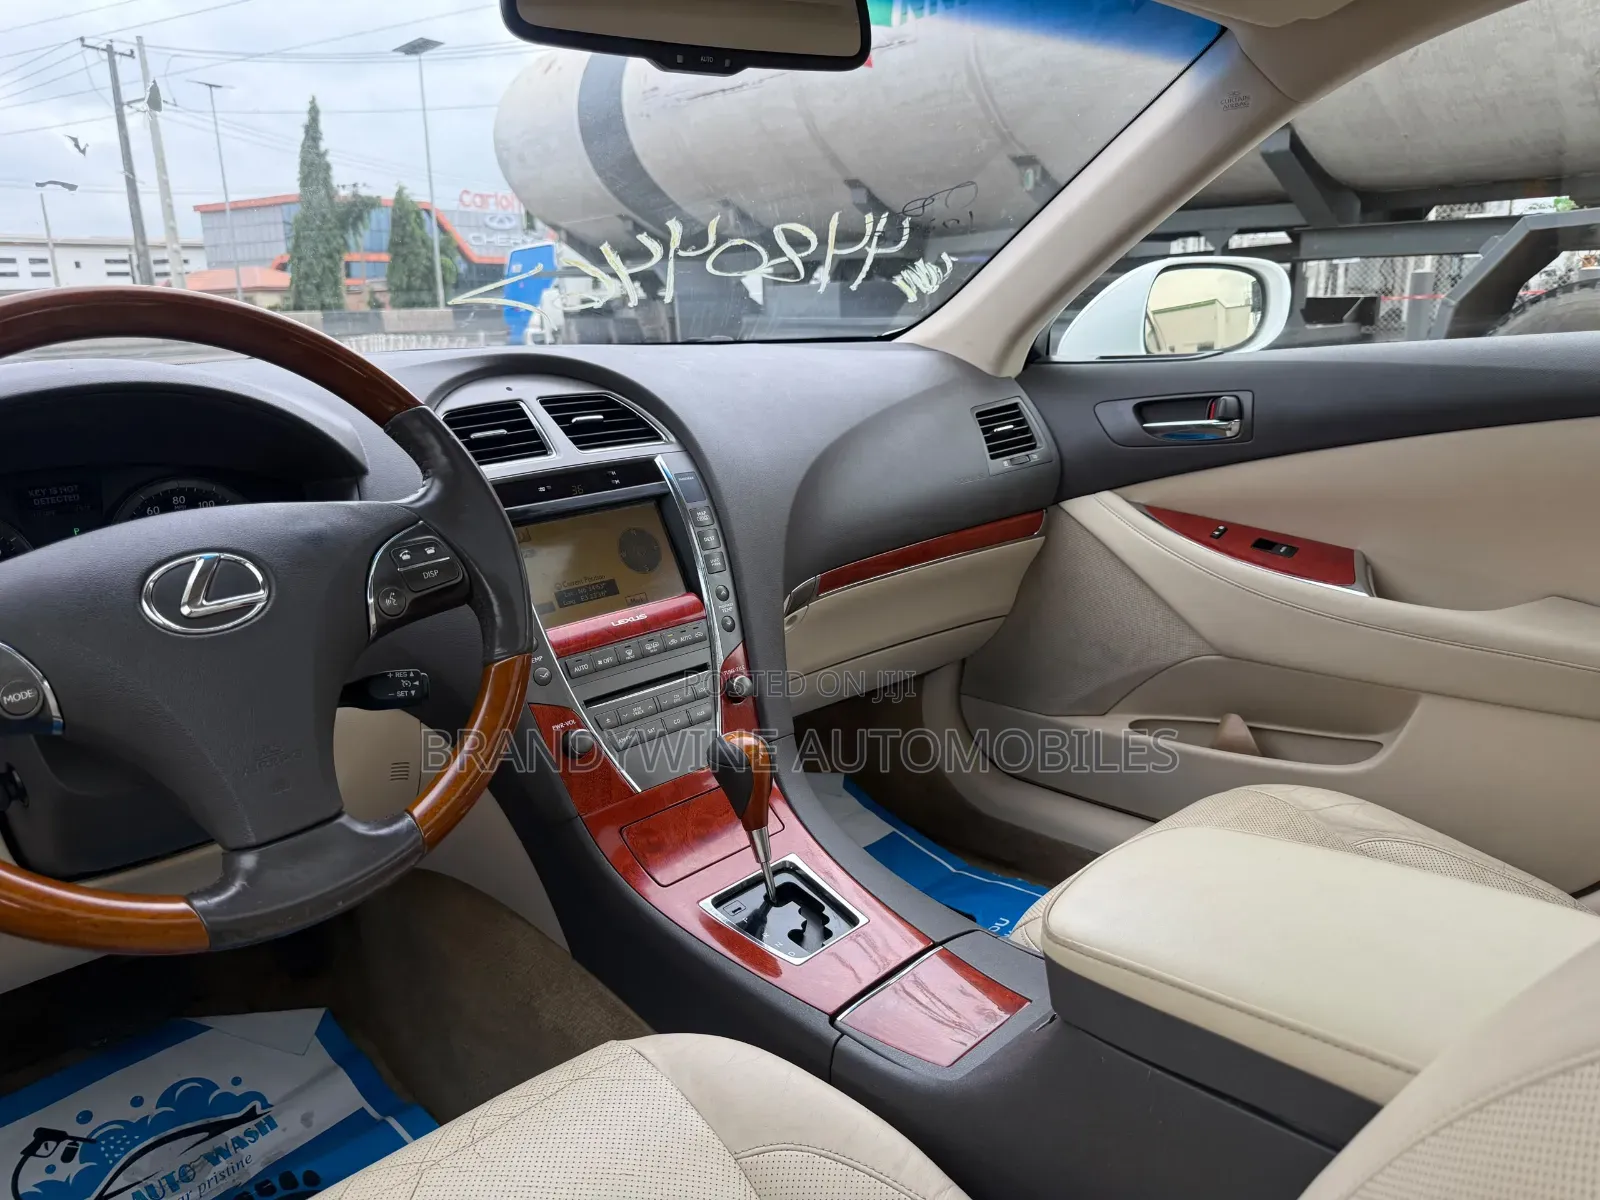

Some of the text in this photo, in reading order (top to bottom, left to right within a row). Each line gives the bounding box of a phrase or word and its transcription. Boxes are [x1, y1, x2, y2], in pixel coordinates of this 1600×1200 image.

[1220, 95, 1250, 105] CURTAIN
[1223, 101, 1250, 109] AIRBAG
[60, 484, 79, 494] NOT
[33, 493, 80, 506] DETECTED
[172, 495, 186, 505] 80
[198, 500, 215, 509] 100
[146, 505, 160, 516] 60
[73, 527, 80, 536] P
[422, 569, 439, 580] DISP
[611, 613, 648, 627] LEXUS
[680, 634, 692, 643] AUTO
[531, 655, 543, 664] EMP
[603, 656, 613, 664] OFF
[574, 663, 589, 673] AUTO
[3, 689, 35, 705] MODE
[396, 688, 409, 697] SET
[131, 1114, 279, 1200] AUTO WASH
[196, 1153, 253, 1198] pristine
